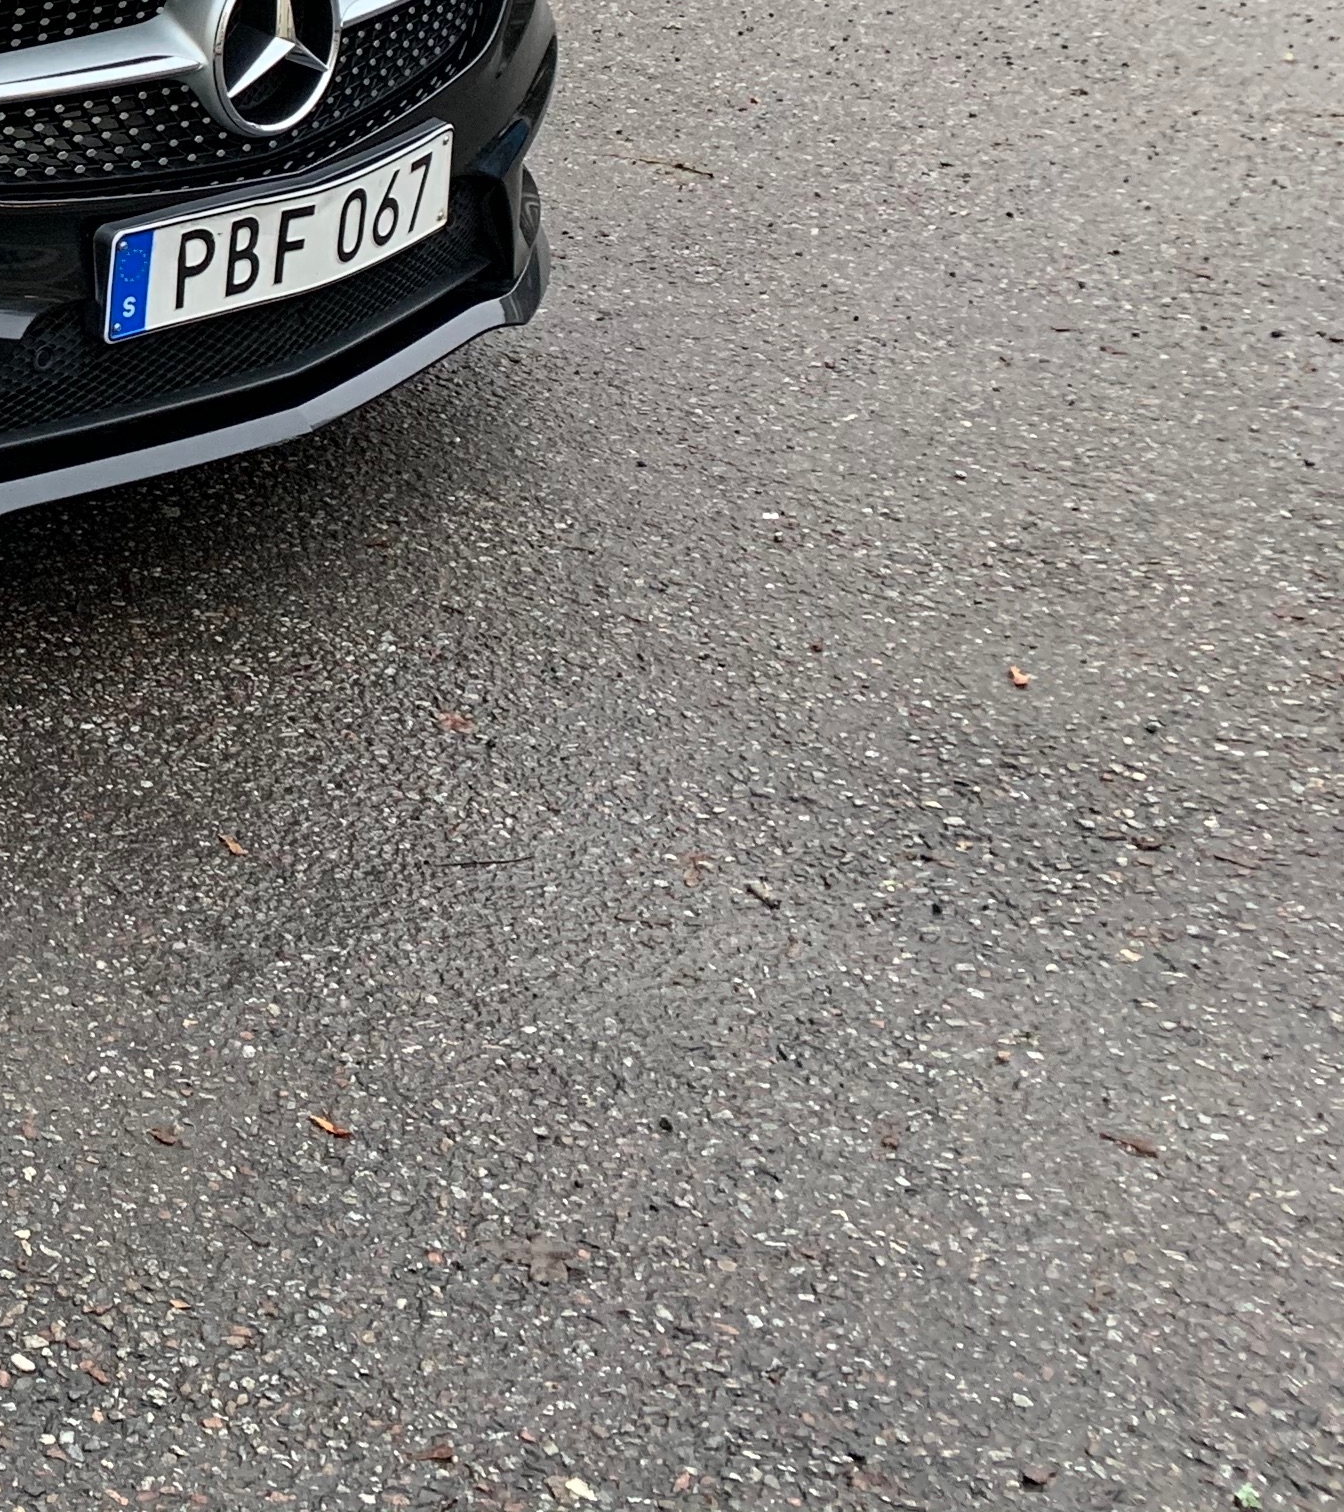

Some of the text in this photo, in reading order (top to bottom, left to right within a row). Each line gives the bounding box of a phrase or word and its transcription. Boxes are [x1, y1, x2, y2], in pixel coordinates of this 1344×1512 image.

[175, 151, 433, 310] PBF 067
[122, 296, 137, 318] S
